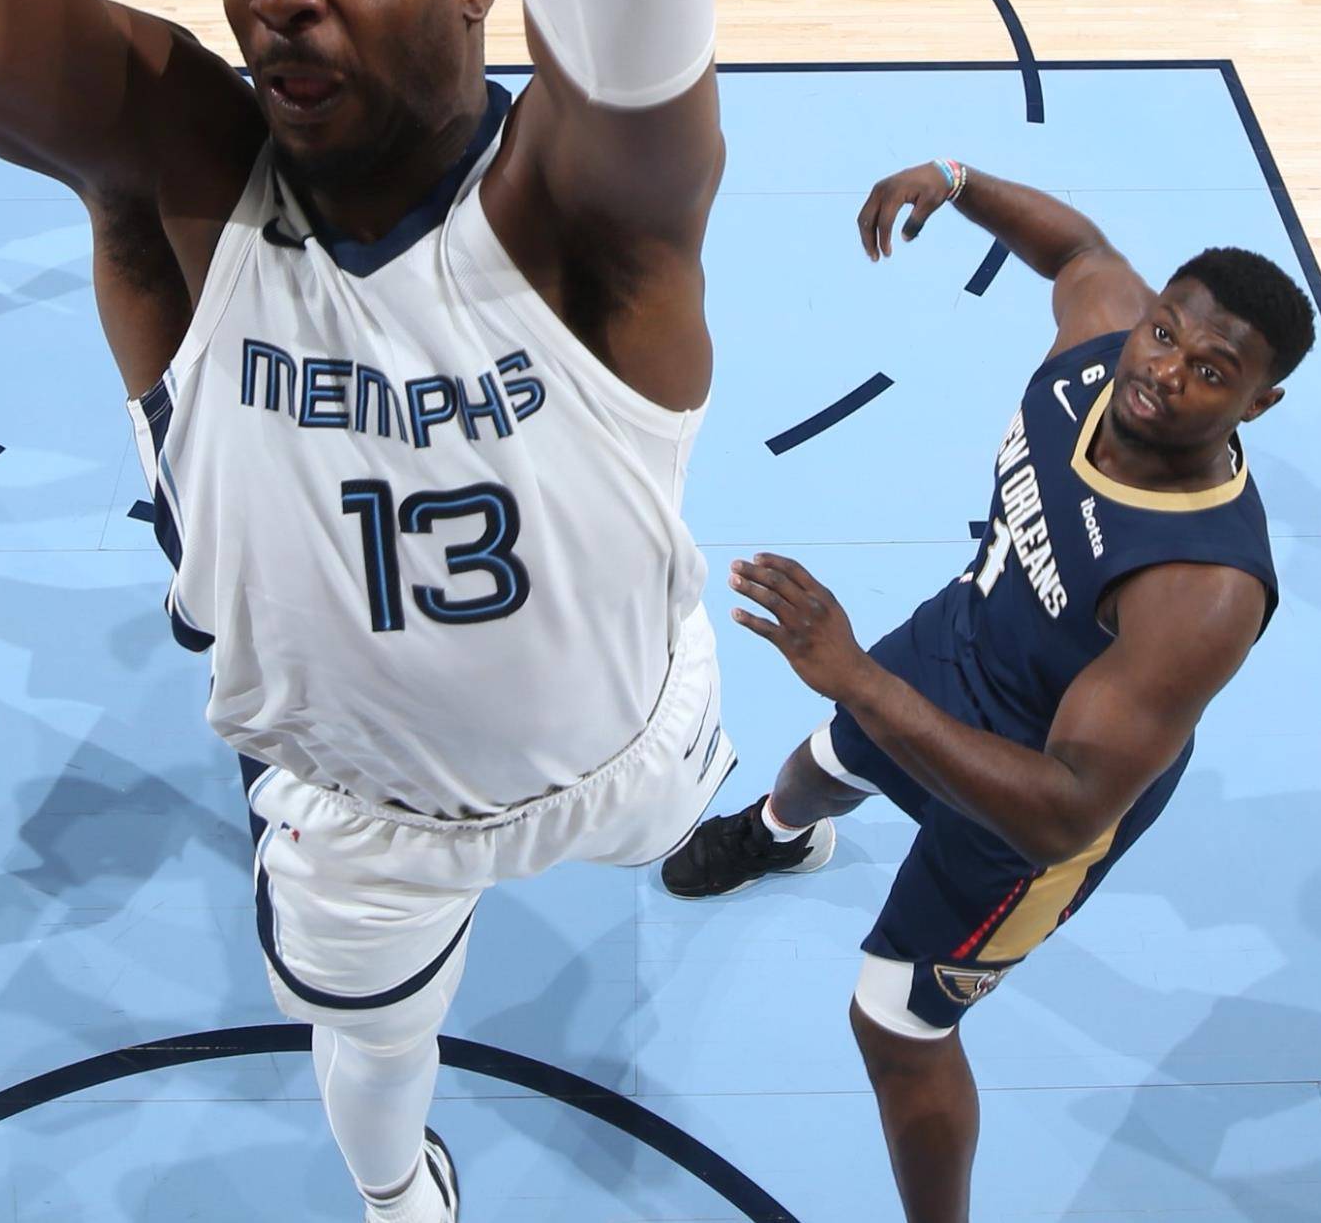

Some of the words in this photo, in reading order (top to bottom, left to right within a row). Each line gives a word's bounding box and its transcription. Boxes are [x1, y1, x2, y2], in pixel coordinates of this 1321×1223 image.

[240, 337, 546, 450] MEMPHS
[1081, 363, 1106, 386] 6
[339, 478, 531, 633] 13
[1000, 464, 1068, 619] ORLEANS
[1080, 495, 1105, 559] ibotta
